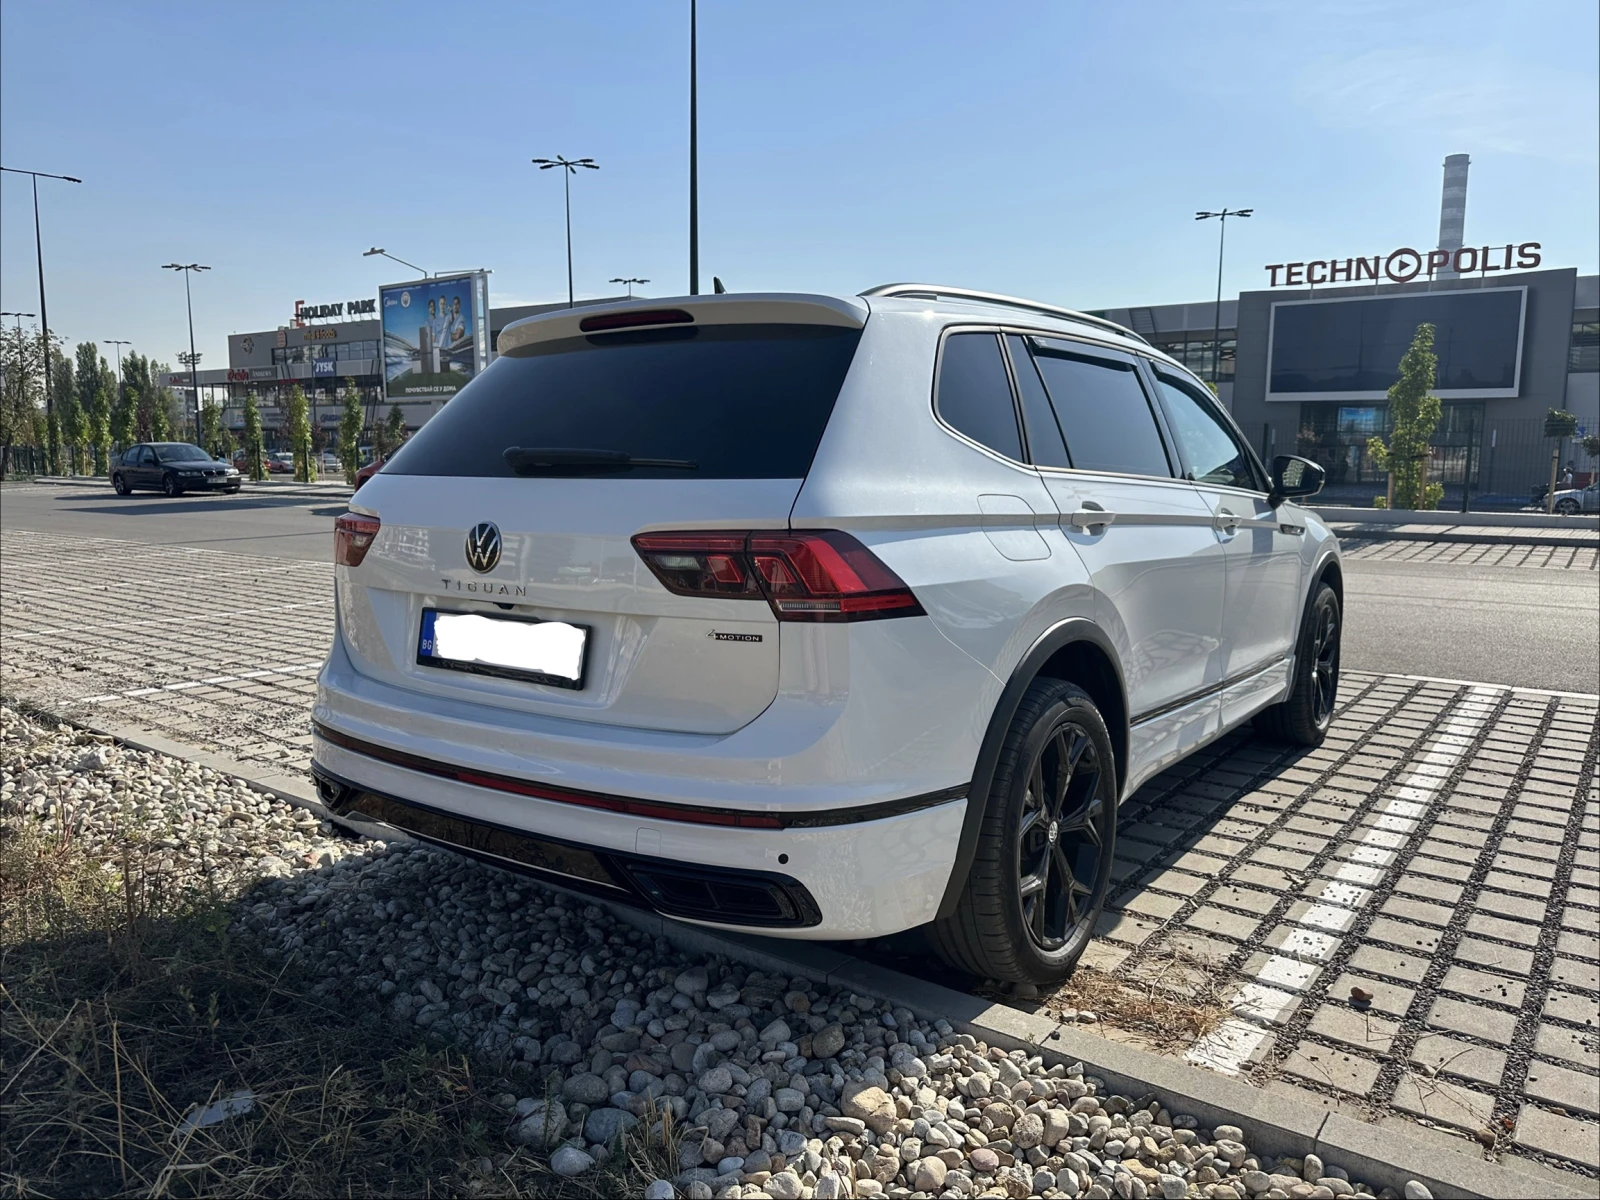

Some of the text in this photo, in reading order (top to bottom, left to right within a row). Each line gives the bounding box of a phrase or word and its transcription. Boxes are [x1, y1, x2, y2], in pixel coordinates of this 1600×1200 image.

[1265, 242, 1541, 287] TECHNOPOLIS
[301, 299, 376, 319] HOLIDAY PARK
[315, 361, 334, 373] JYSK
[405, 385, 433, 394] ПОЧУВСТВАЙ
[443, 385, 456, 393] ДОМА
[441, 578, 526, 597] TIGUAN
[705, 624, 761, 642] 4MOTION
[422, 639, 432, 650] BG
